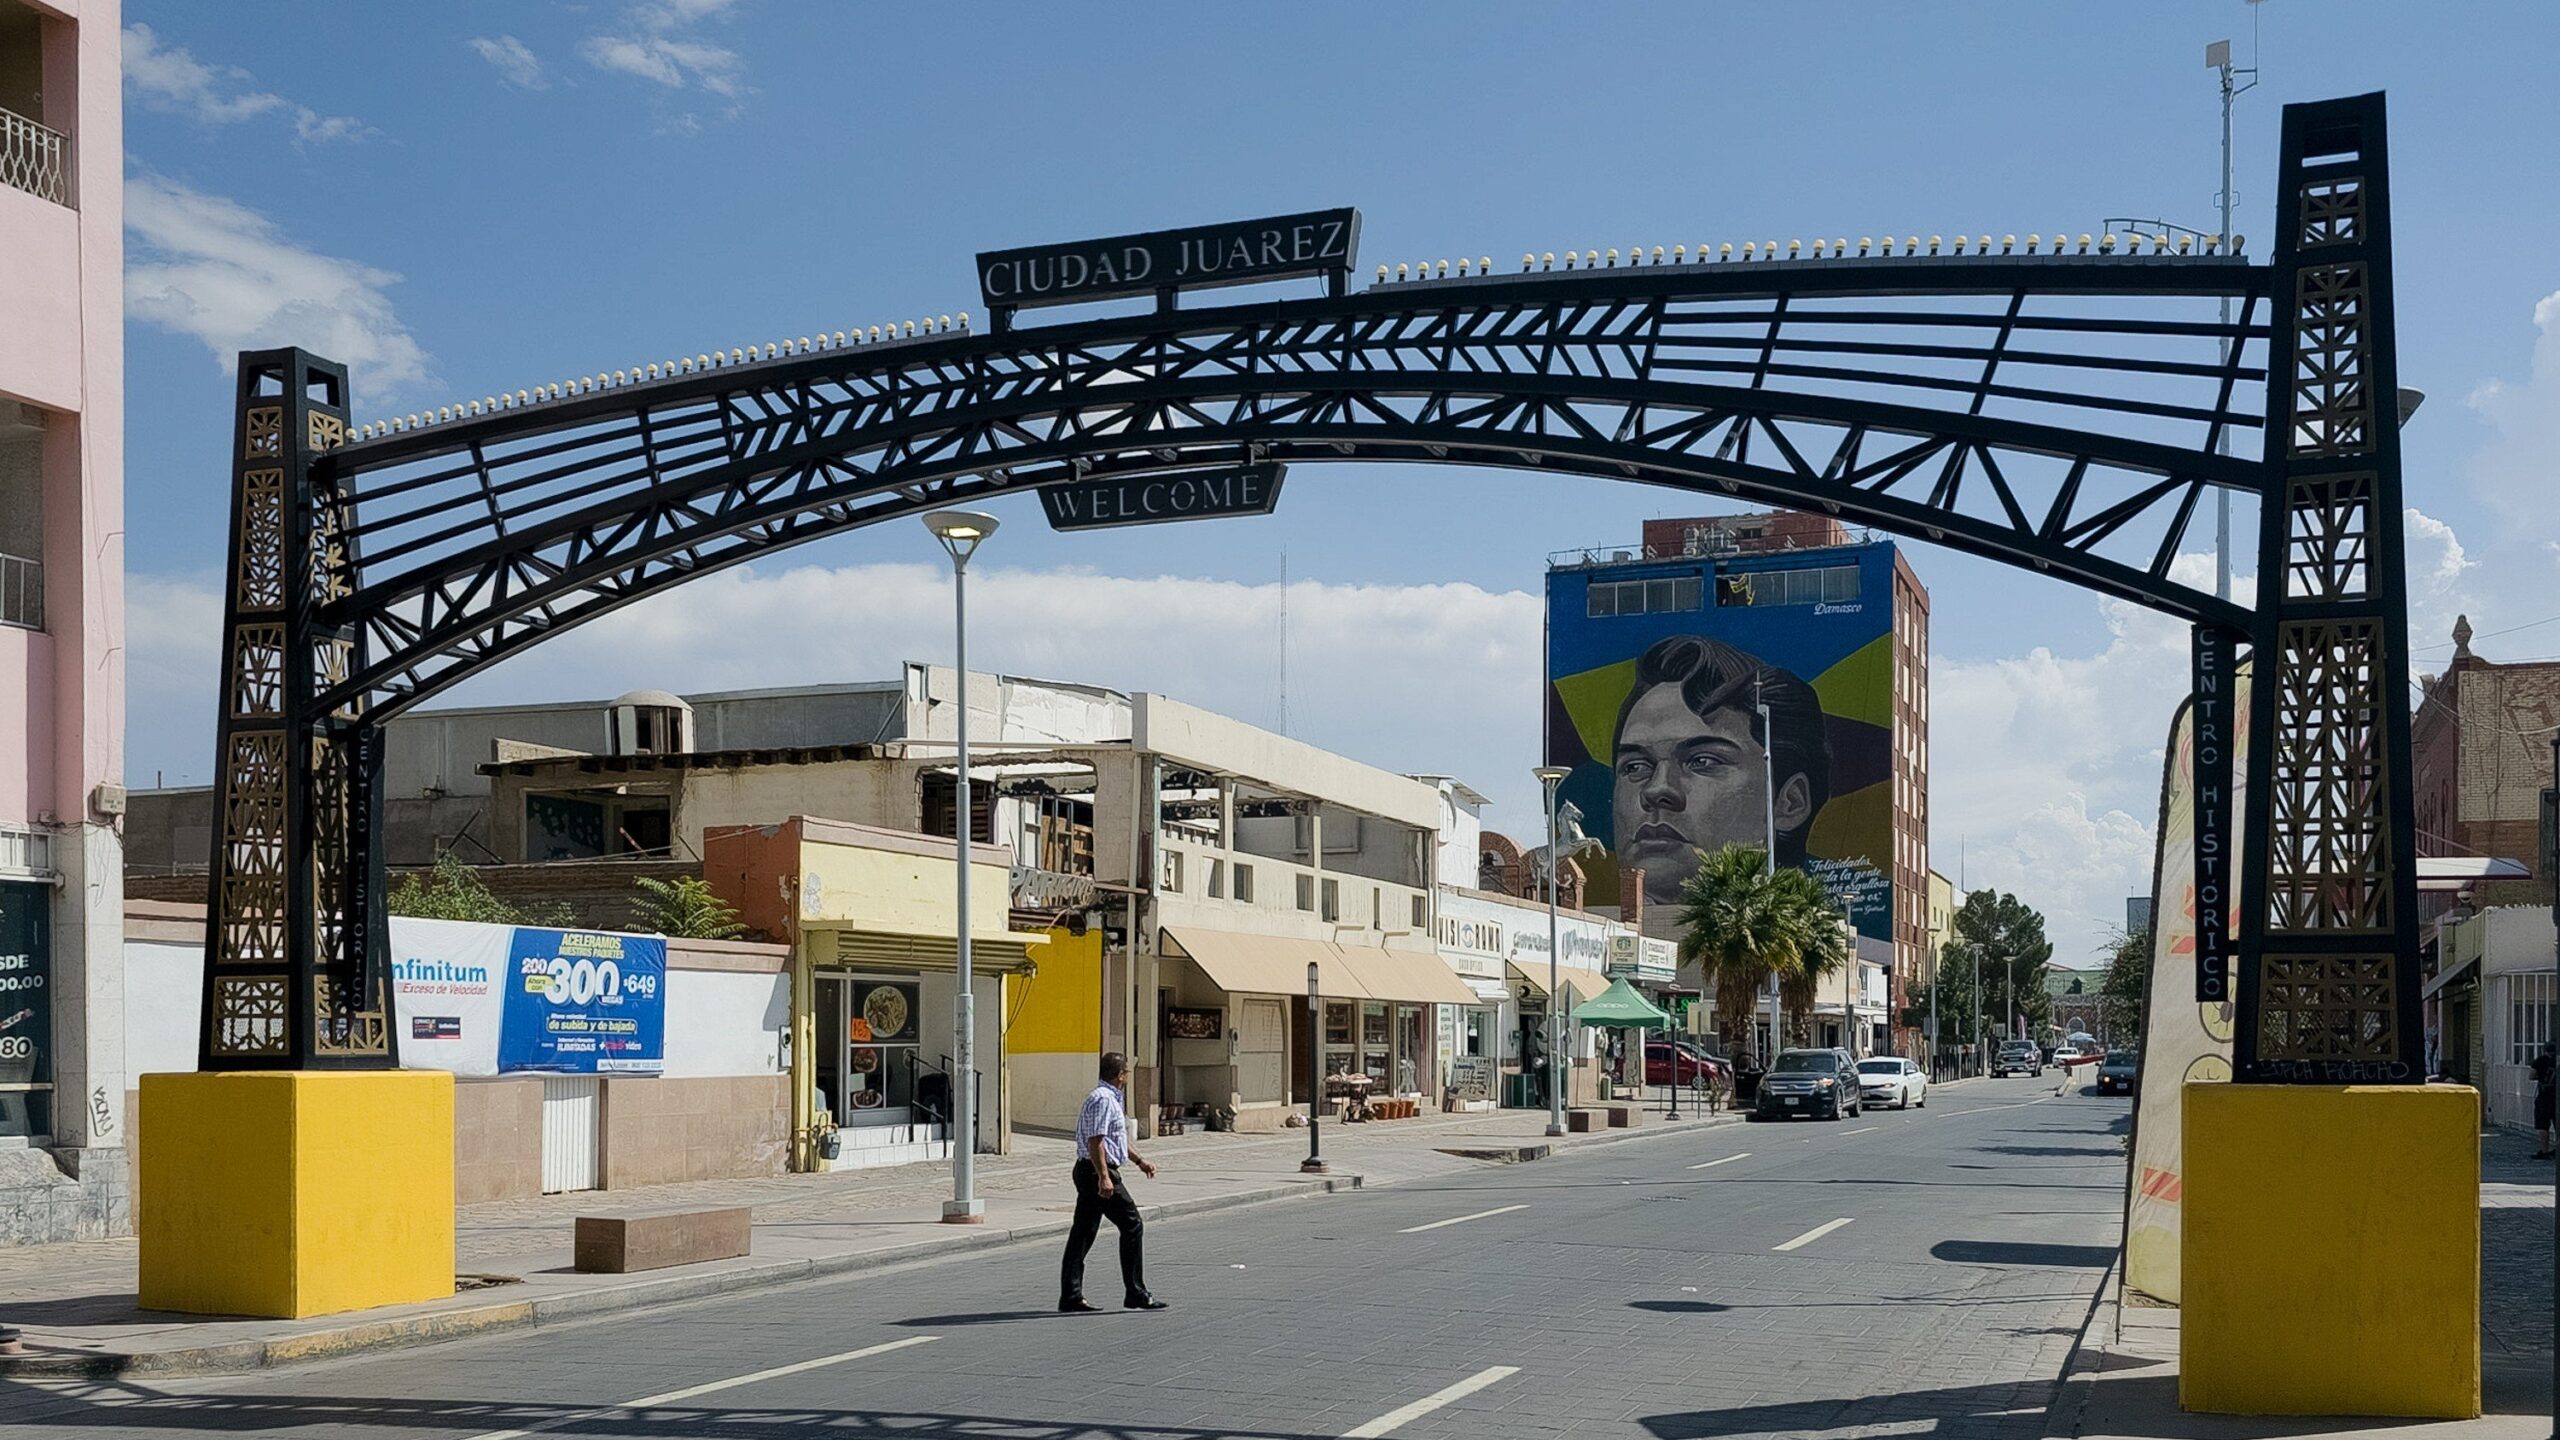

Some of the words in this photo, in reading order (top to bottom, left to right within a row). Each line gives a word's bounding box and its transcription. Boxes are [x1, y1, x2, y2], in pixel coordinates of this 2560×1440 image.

[985, 246, 1152, 297] CIUDAD
[1176, 220, 1346, 276] JUAREZ
[1052, 474, 1260, 520] WELCOME
[1813, 603, 1863, 615] Damasco
[2199, 628, 2219, 766] CENTRO
[357, 729, 369, 833] CENTRO
[561, 933, 622, 950] ACELERAMOS
[592, 949, 625, 959] PAQUETES
[391, 959, 488, 982] nfinitum
[544, 957, 620, 1006] 300
[402, 983, 435, 994] Exceso
[436, 983, 447, 994] de
[449, 983, 488, 995] Velocidad
[548, 1020, 560, 1030] de
[560, 1020, 588, 1030] subida
[589, 1022, 597, 1032] y
[597, 1020, 608, 1030] de
[608, 1020, 636, 1033] bajada
